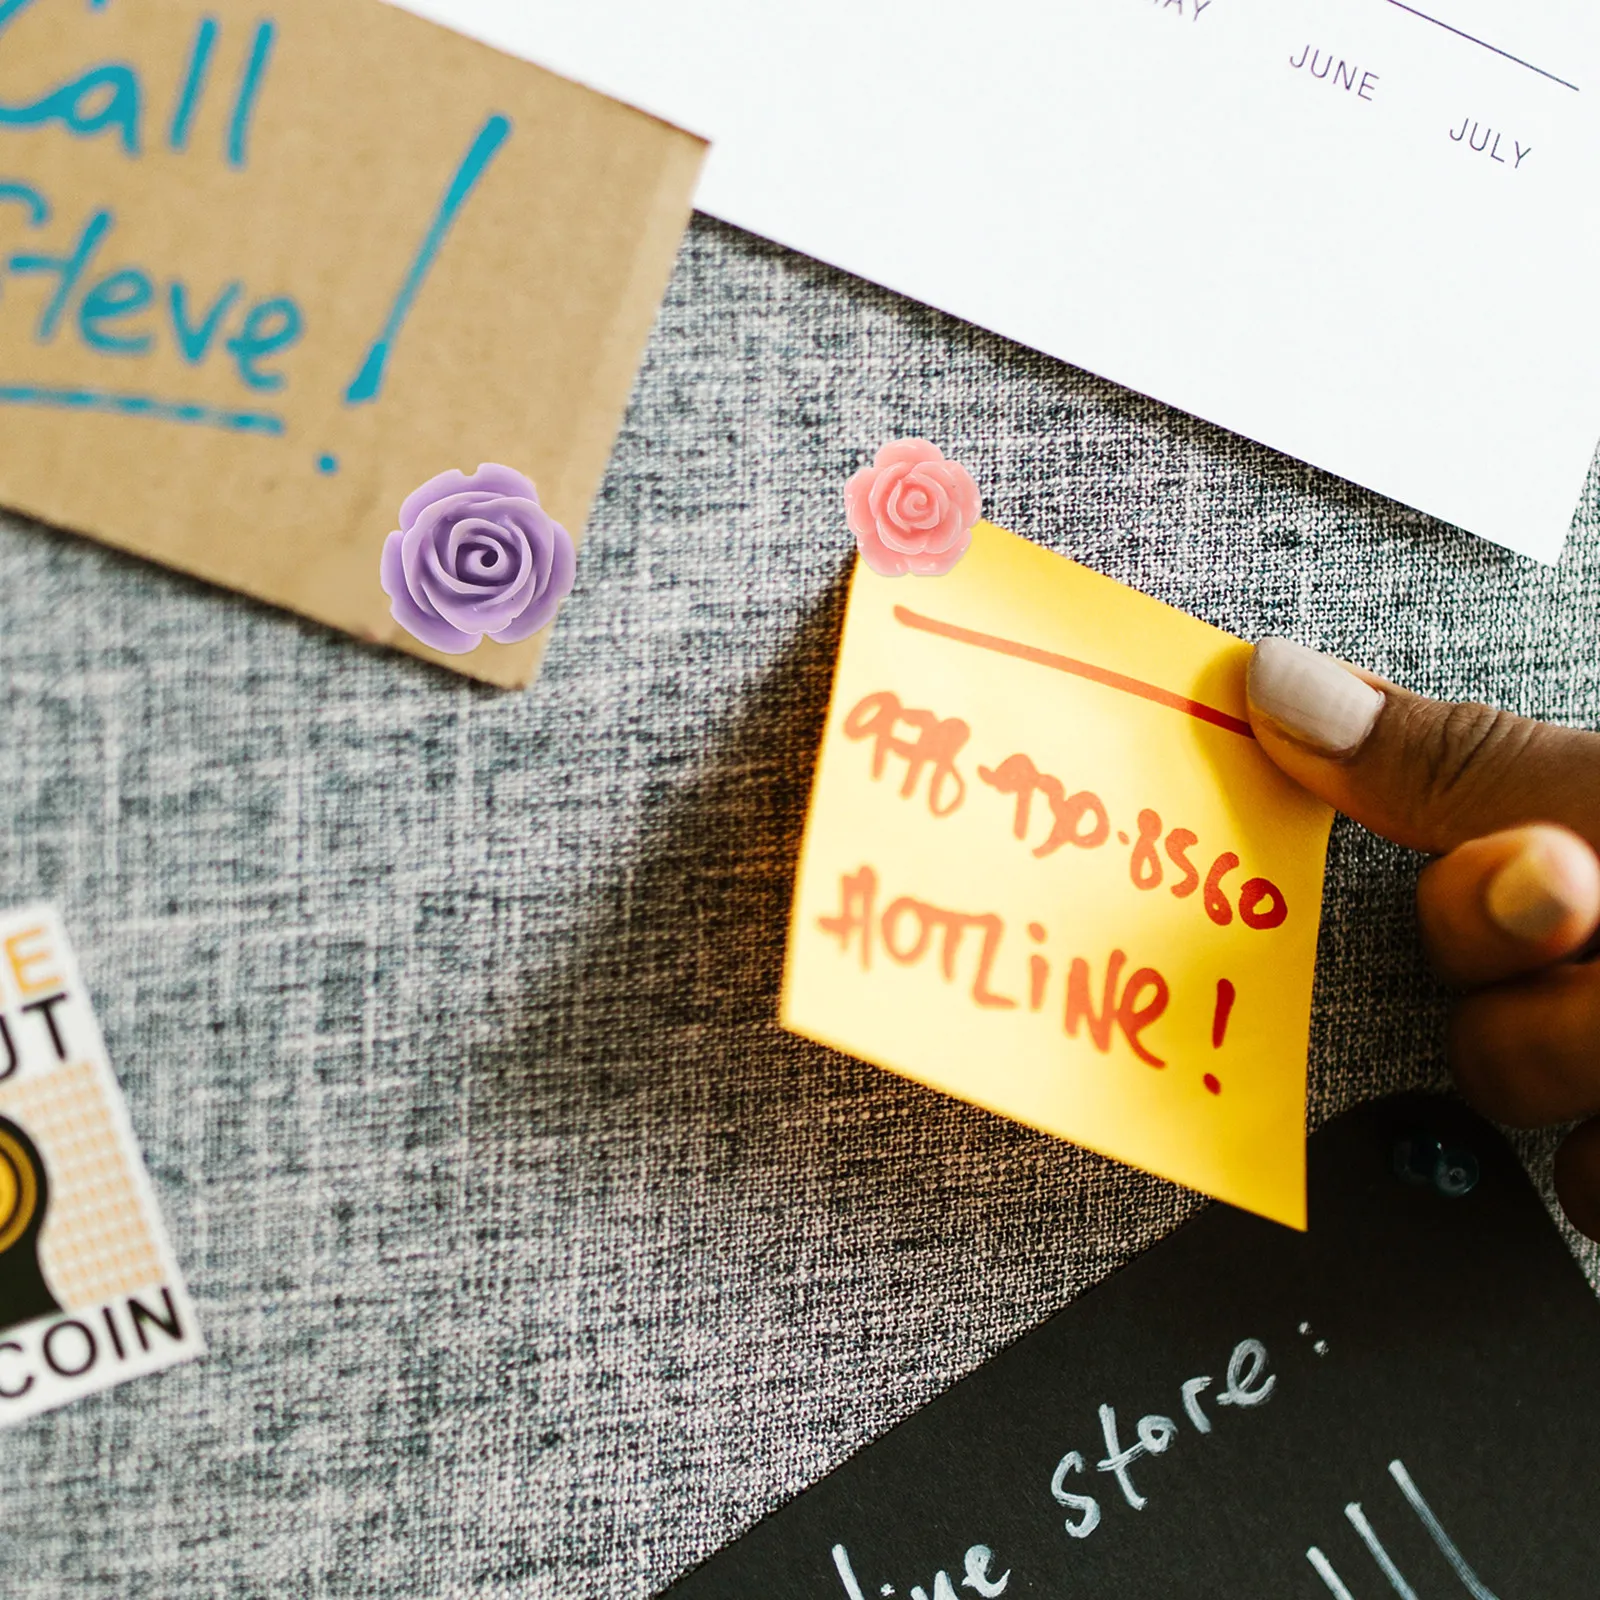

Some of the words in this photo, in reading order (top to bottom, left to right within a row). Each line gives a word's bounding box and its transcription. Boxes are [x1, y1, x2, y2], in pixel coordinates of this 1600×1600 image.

[1153, 0, 1212, 22] AY
[1289, 44, 1380, 101] JUNE
[1449, 117, 1532, 169] JULY
